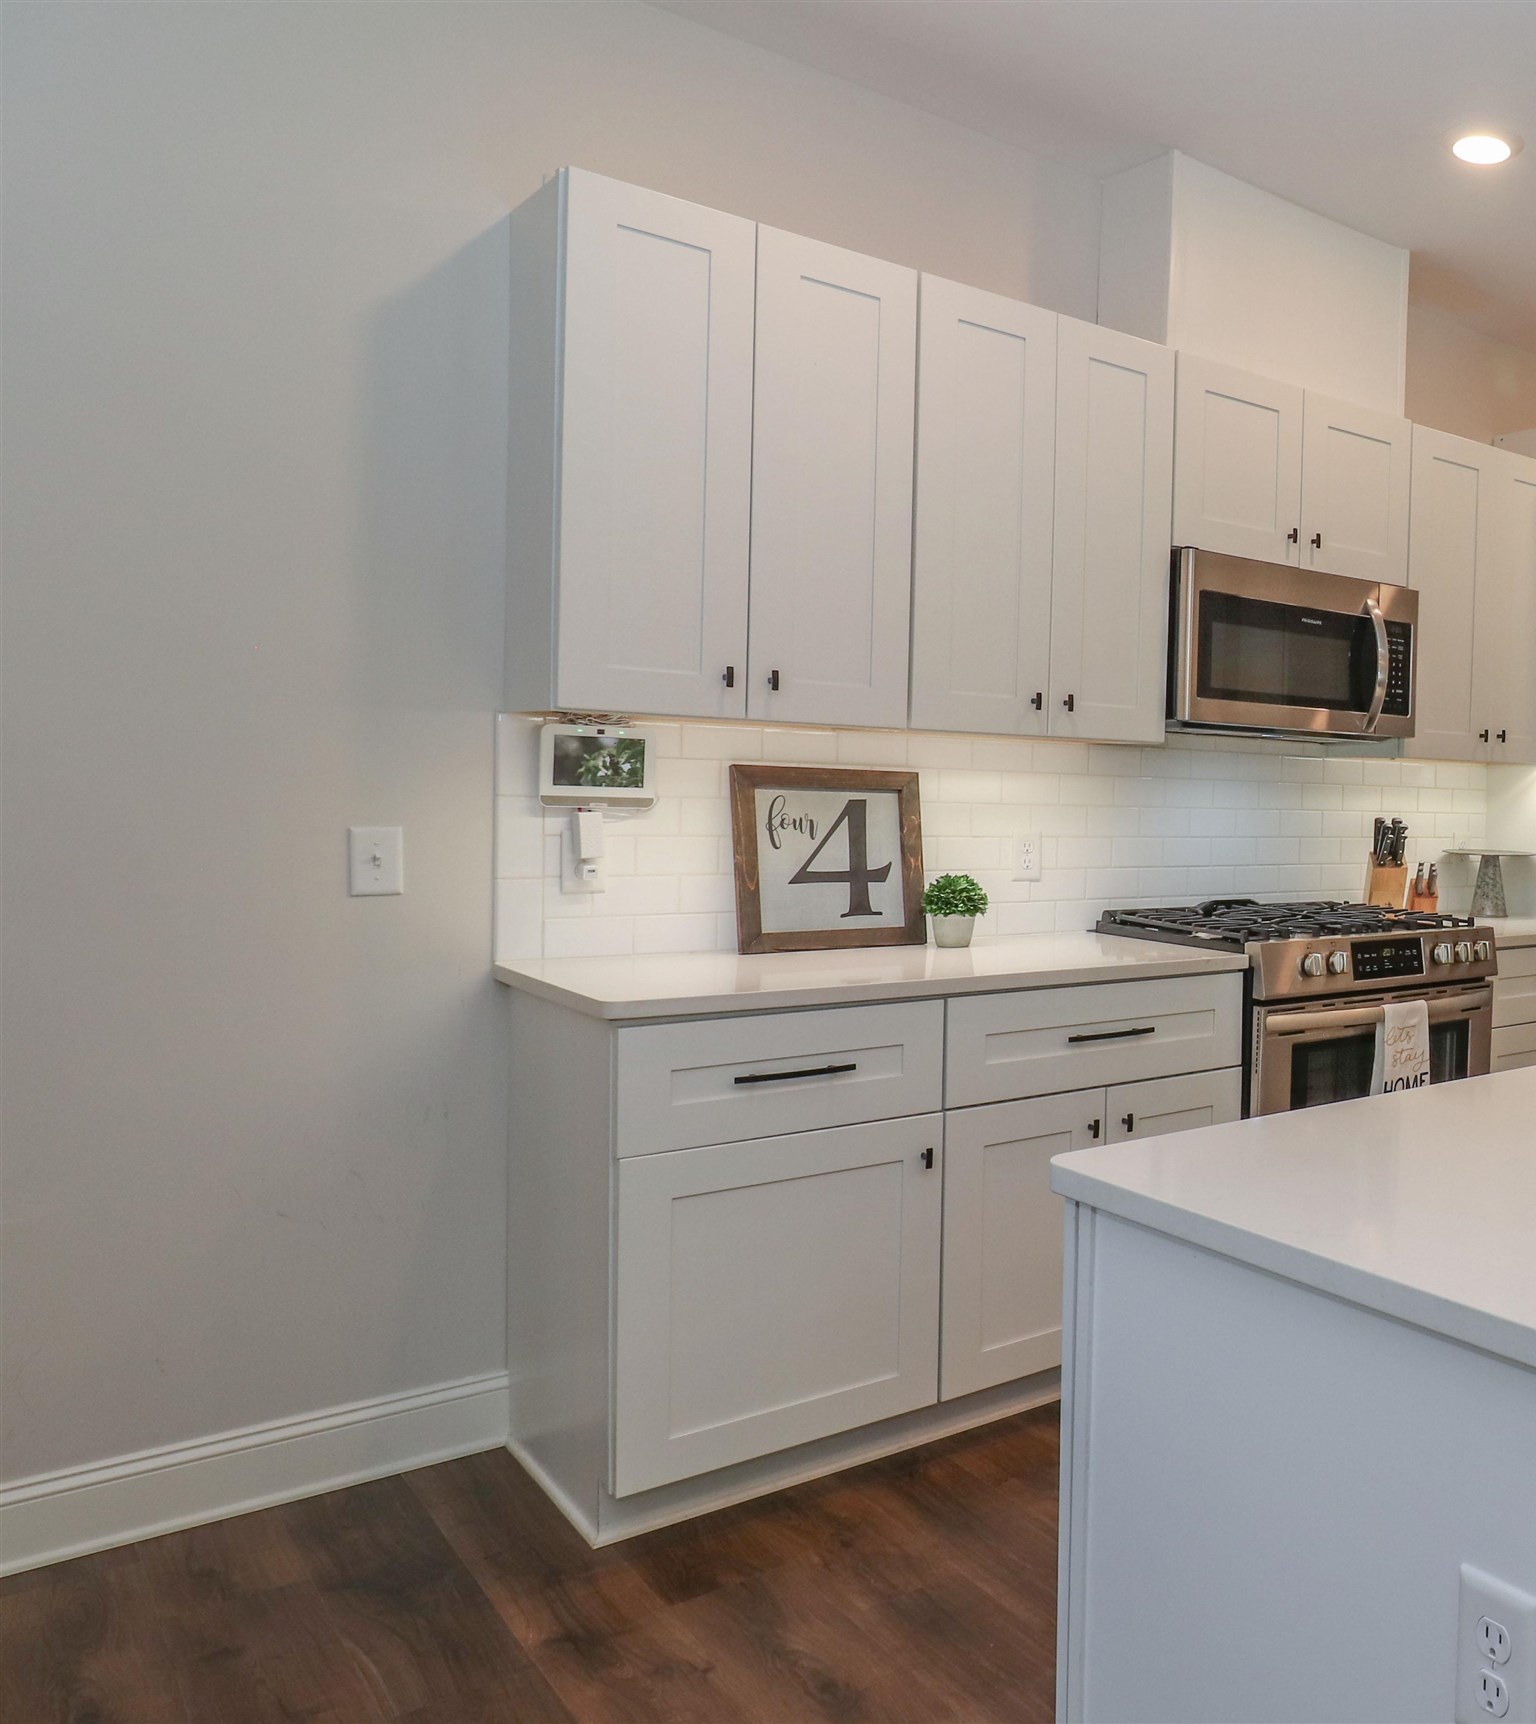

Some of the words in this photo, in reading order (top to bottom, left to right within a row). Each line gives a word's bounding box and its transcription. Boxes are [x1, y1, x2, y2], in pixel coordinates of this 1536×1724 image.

[765, 795, 818, 850] four
[788, 799, 893, 918] 4
[1392, 1047, 1430, 1072] stay
[1383, 1072, 1429, 1093] HOME
